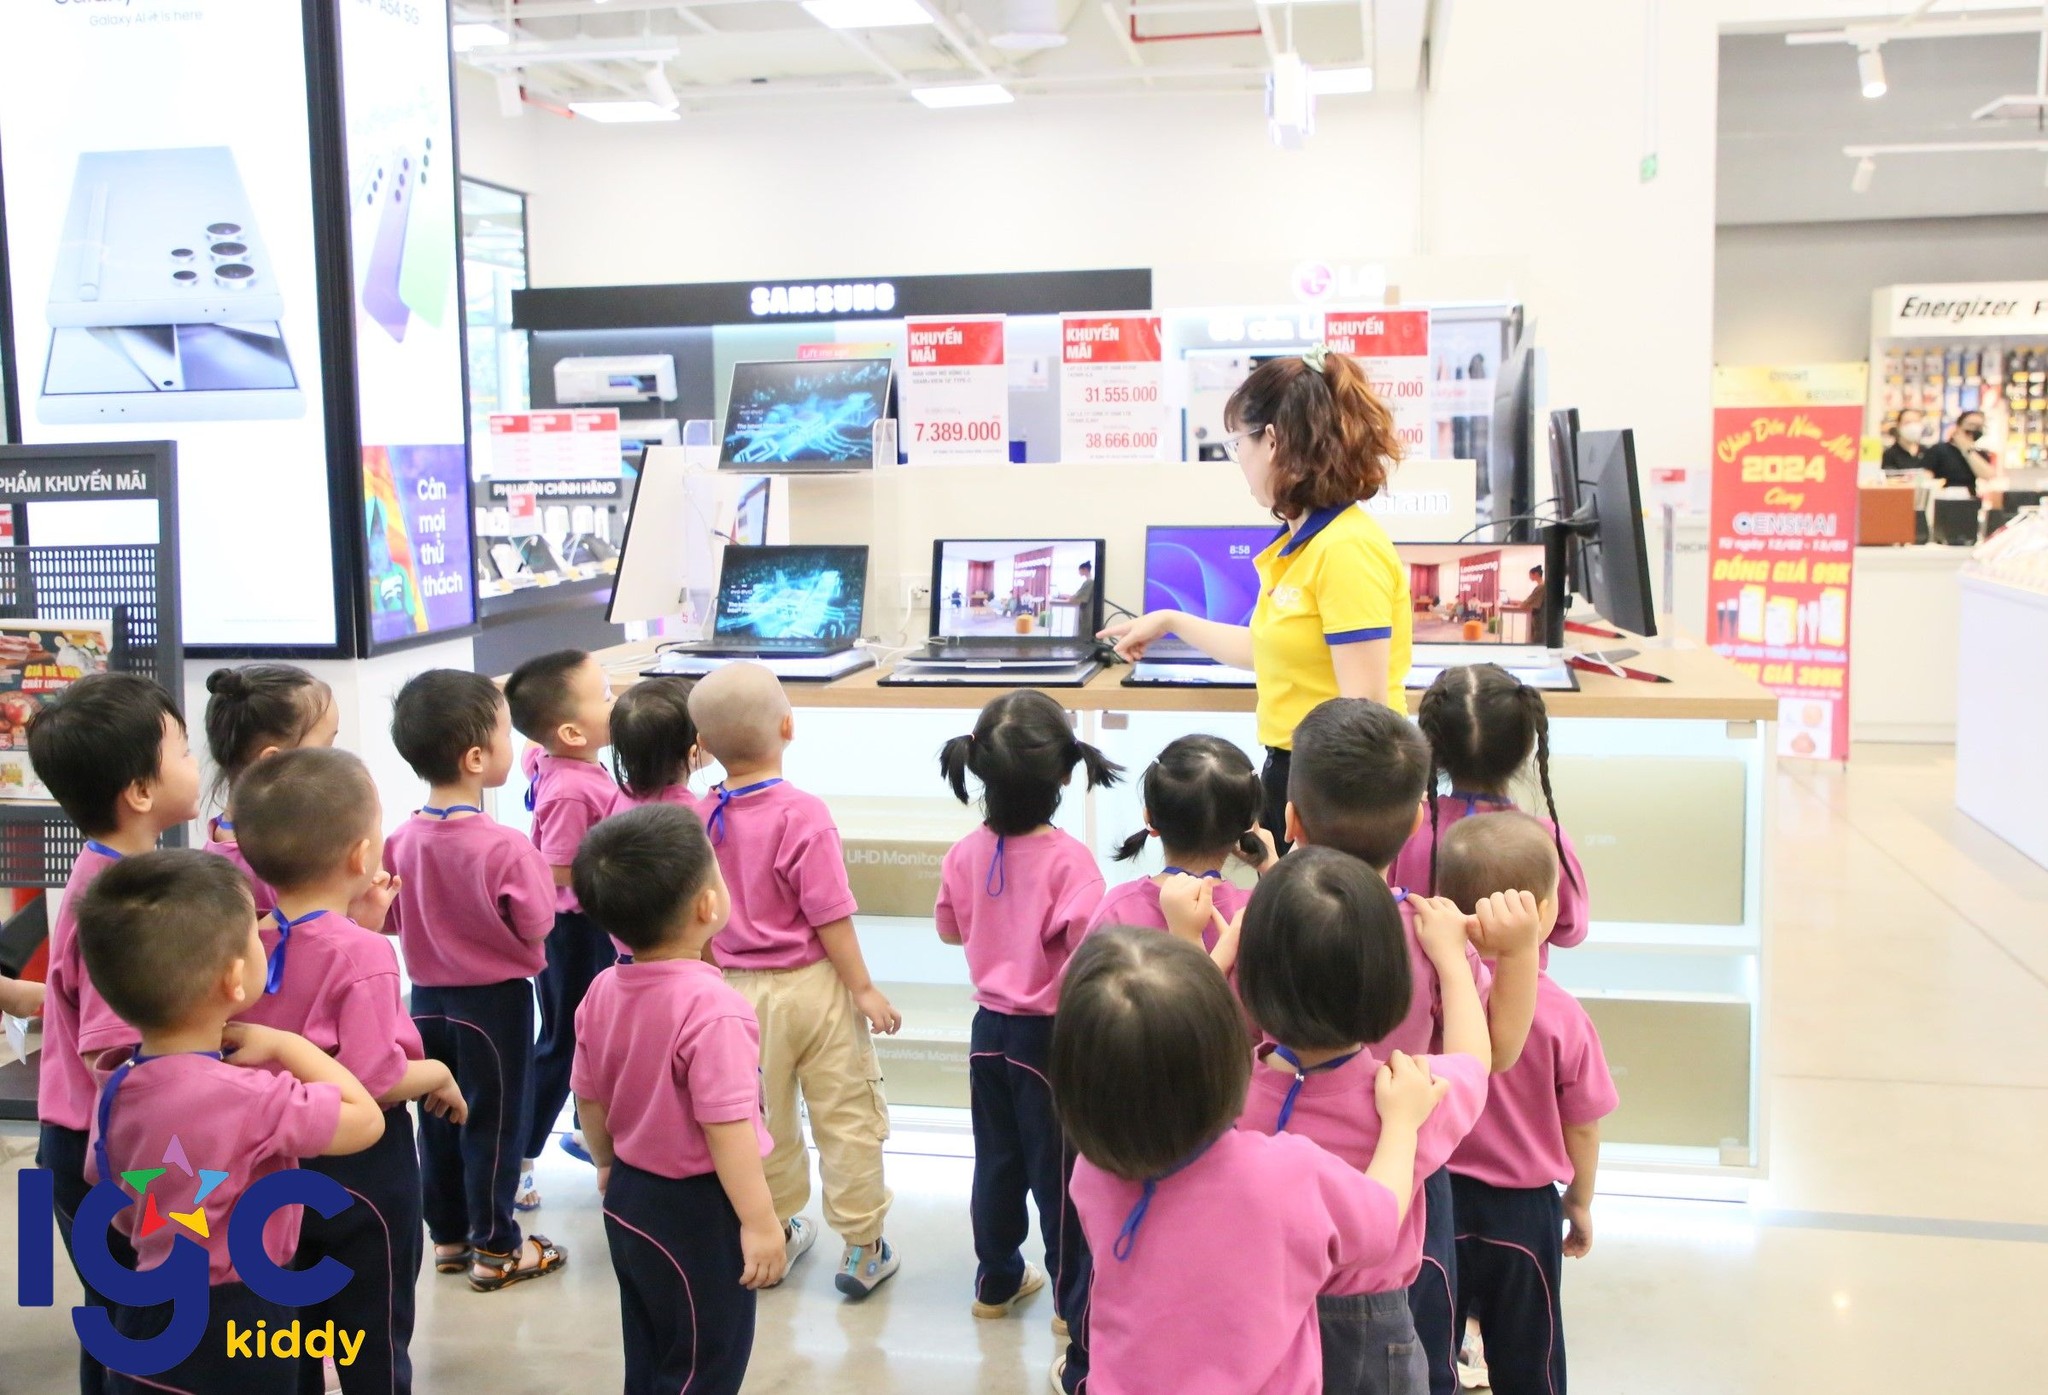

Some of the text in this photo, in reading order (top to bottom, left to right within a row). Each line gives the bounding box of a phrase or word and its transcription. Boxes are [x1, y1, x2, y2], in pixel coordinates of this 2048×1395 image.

[88, 14, 131, 28] Galaxy
[160, 11, 171, 22] is
[173, 9, 204, 22] here
[751, 282, 895, 316] SAMSUNG
[1900, 296, 2018, 323] Energizer
[910, 326, 963, 345] KHUYẾN
[1065, 322, 1120, 342] KHUYẾN
[1327, 316, 1385, 335] KHUYẾN
[910, 346, 937, 362] MÃI
[1065, 342, 1093, 359] MÃI
[1085, 386, 1158, 403] 31.555.000
[914, 421, 1001, 442] 7.389.000
[1085, 432, 1158, 448] 38.666.000
[1741, 455, 1827, 483] 2024
[45, 467, 113, 493] KHUYẾN
[116, 469, 147, 491] MÃI
[419, 507, 446, 537] mọi
[421, 538, 445, 566] thử
[1229, 544, 1251, 555] 8:58
[1772, 557, 1808, 584] GIÁ
[423, 570, 464, 597] thách
[846, 848, 881, 865] UHD
